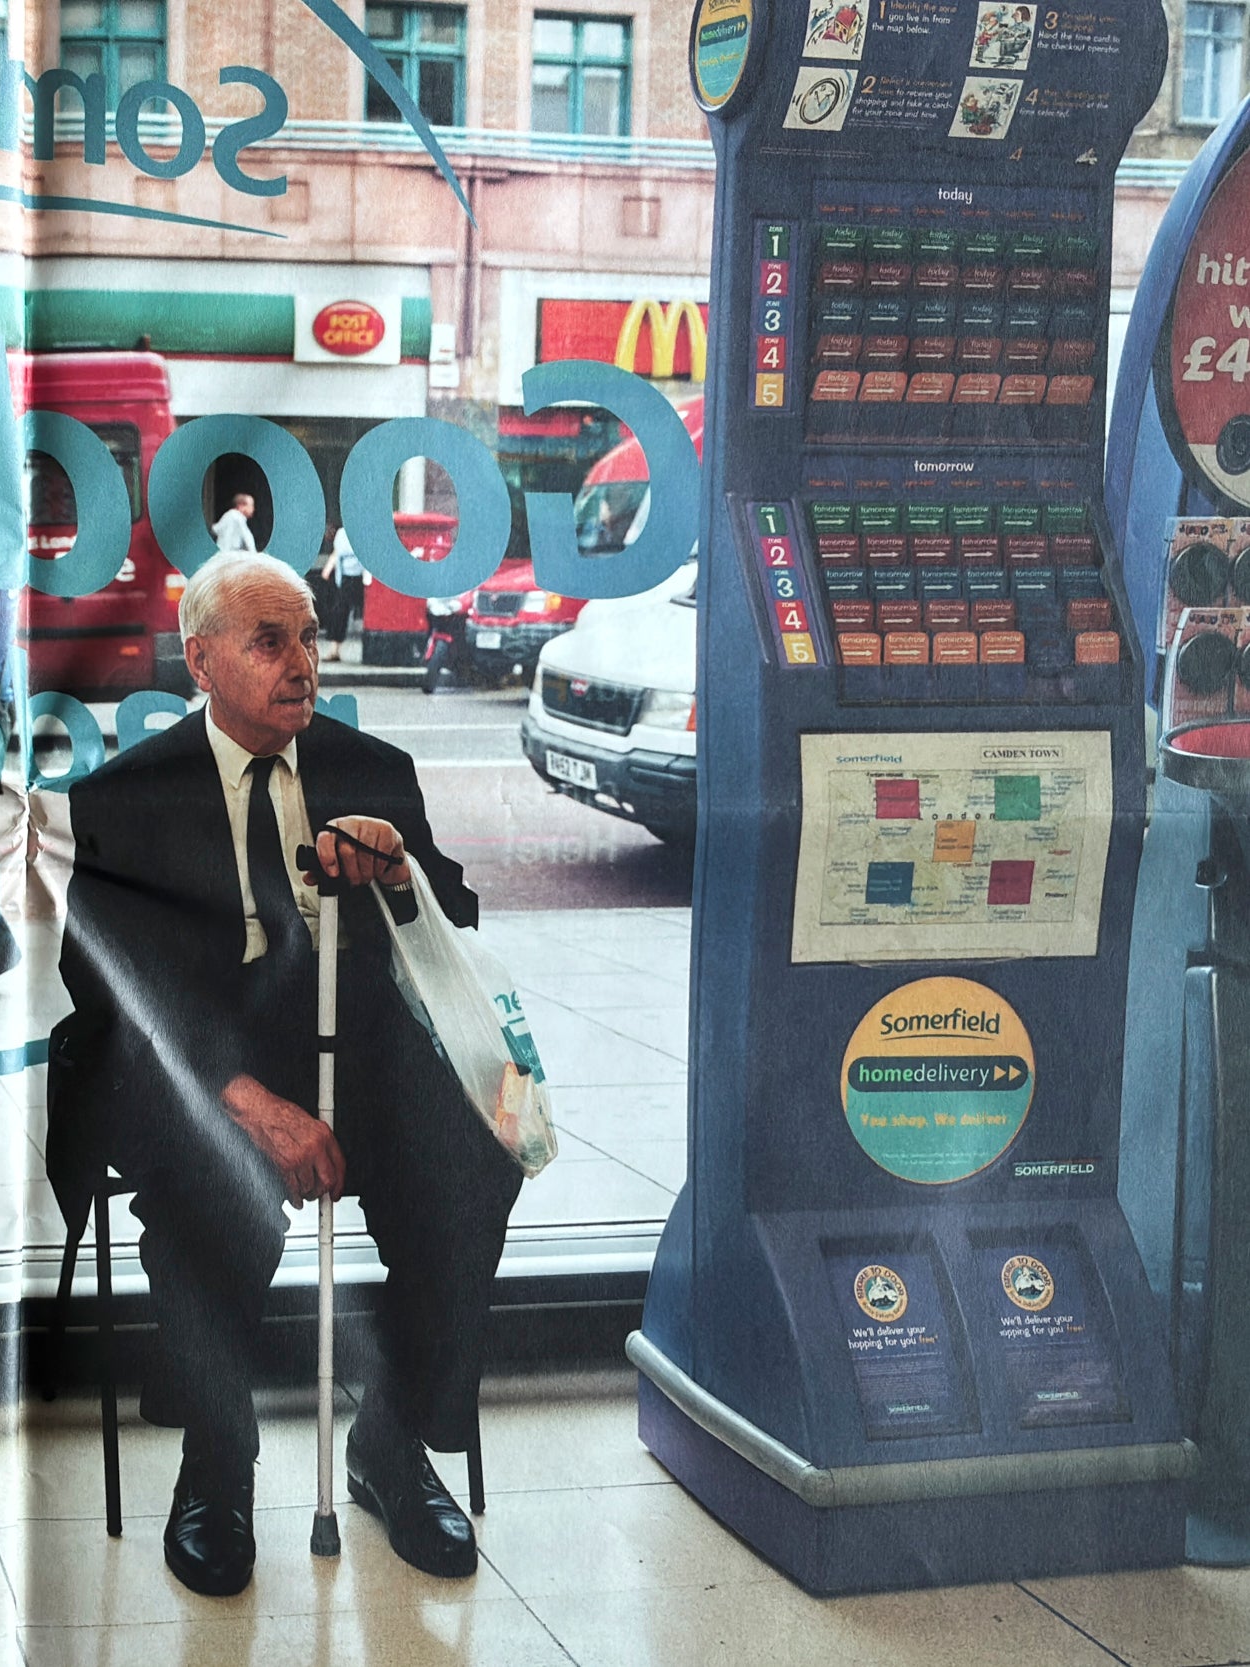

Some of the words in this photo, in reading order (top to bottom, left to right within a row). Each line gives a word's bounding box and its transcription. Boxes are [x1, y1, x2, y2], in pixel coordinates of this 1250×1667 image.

[888, 14, 904, 23] you
[906, 13, 920, 22] live
[932, 14, 951, 24] from
[1044, 11, 1058, 30] 3
[872, 22, 884, 31] the
[887, 25, 904, 34] map
[1037, 41, 1049, 49] the
[861, 76, 877, 94] 2
[1025, 88, 1039, 106] 4
[938, 188, 973, 204] today
[835, 228, 857, 238] today
[881, 229, 903, 239] today
[929, 230, 951, 241] today
[772, 235, 779, 257] 1
[832, 265, 854, 274] today
[879, 266, 901, 276] today
[928, 267, 950, 277] today
[974, 269, 996, 279] today
[766, 272, 782, 294] 2
[831, 301, 853, 311] today
[925, 304, 946, 314] today
[329, 313, 370, 329] POST
[764, 309, 781, 332] 3
[323, 329, 375, 346] OFFICE
[763, 346, 780, 369] 4
[762, 384, 778, 405] 5
[914, 460, 975, 473] tomorrow
[814, 505, 850, 513] tomorrow
[861, 506, 897, 515] tomorrow
[908, 505, 945, 514] tomorrow
[953, 505, 989, 514] tomorrow
[1002, 506, 1039, 515] tomorrow
[766, 515, 776, 534] 1
[819, 538, 857, 546] tomorrow
[867, 538, 903, 546] tomorrow
[915, 537, 951, 546] tomorrow
[962, 538, 998, 546] tomorrow
[1009, 539, 1045, 547] tomorrow
[770, 546, 788, 566] 2
[827, 570, 863, 579] tomorrow
[874, 570, 911, 579] tomorrow
[922, 570, 958, 579] tomorrow
[967, 569, 1004, 578] tomorrow
[777, 578, 794, 598] 3
[834, 603, 870, 612] tomorrow
[881, 604, 918, 612] tomorrow
[929, 603, 966, 612] tomorrow
[785, 610, 802, 630] 4
[792, 643, 809, 663] 5
[836, 755, 902, 764] Somerfield
[983, 750, 1027, 760] CAMDEN
[1030, 749, 1060, 758] TOWN
[880, 1007, 1000, 1035] Somerfield
[859, 1063, 989, 1087] homedelivery
[860, 1113, 887, 1127] You
[890, 1112, 930, 1129] shop.
[934, 1113, 956, 1127] We
[1014, 1164, 1095, 1177] SOMERFIELD
[1030, 1260, 1052, 1287] DOOR
[885, 1269, 905, 1297] DOOR
[1000, 1315, 1022, 1327] We'll
[1025, 1315, 1052, 1325] deliver
[1054, 1315, 1074, 1327] your
[853, 1327, 875, 1339] We'll
[877, 1325, 904, 1337] deliver
[907, 1326, 926, 1339] your
[1032, 1325, 1045, 1335] for
[1047, 1326, 1064, 1337] you
[848, 1339, 884, 1351] hopping
[885, 1336, 898, 1347] for
[900, 1336, 917, 1348] you
